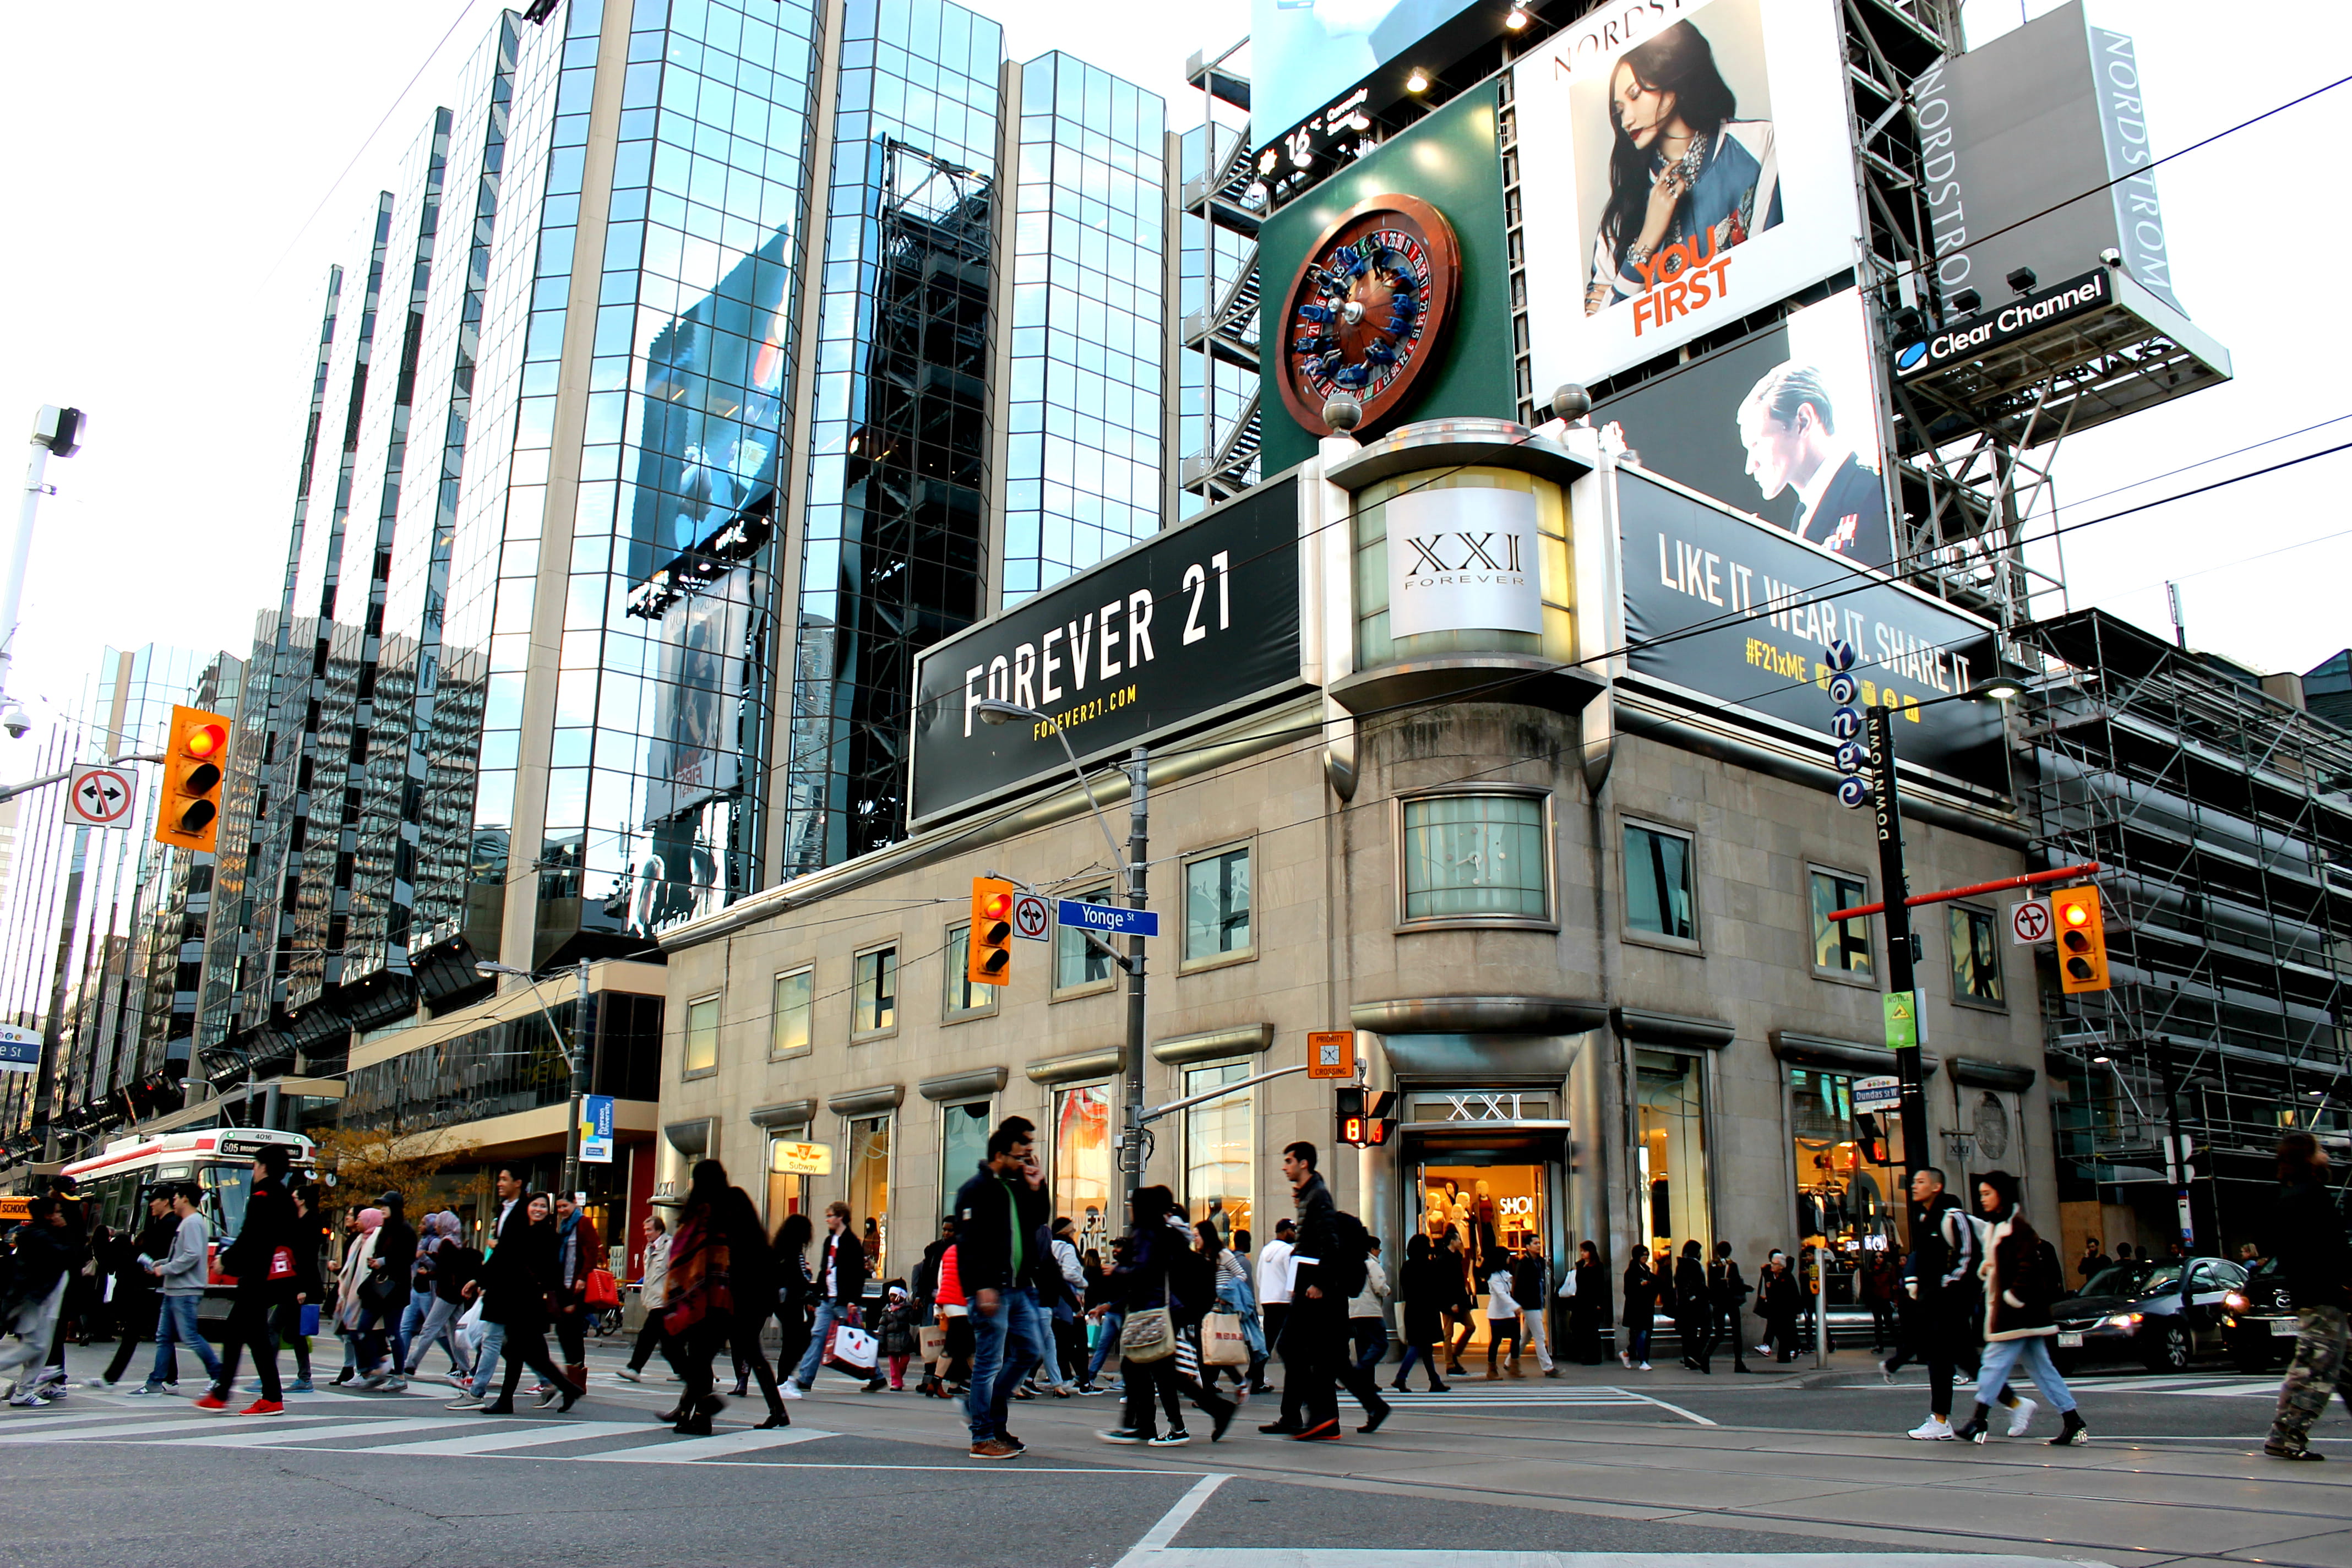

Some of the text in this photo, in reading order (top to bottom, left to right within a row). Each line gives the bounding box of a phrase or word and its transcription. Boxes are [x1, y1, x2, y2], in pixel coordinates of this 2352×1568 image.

[1555, 0, 1680, 81] NORDS
[1285, 126, 1310, 160] 16
[2103, 31, 2170, 288] NORDSTROM
[1387, 232, 1397, 248] 26
[1395, 233, 1405, 250] 30
[1403, 238, 1412, 254] 11
[1413, 253, 1424, 269] 20
[1635, 225, 1716, 294] YOU
[1633, 256, 1732, 337] FIRST
[1419, 300, 1428, 313] 22
[1930, 275, 2102, 358] Clear Channel
[1308, 325, 1320, 335] 21
[1412, 328, 1420, 339] 15
[1403, 532, 1524, 576] XXI
[1405, 575, 1524, 590] FOREVER
[1659, 533, 1723, 607] LIKE
[1763, 575, 1837, 648] WEAR
[1875, 622, 1951, 694] SHARE
[963, 549, 1230, 738] FOREVER 21
[1746, 637, 1807, 684] #F21xME
[1033, 684, 1137, 742] FOREVER21.COM
[1869, 718, 1889, 841] DOWNTOWN
[1082, 905, 1135, 930] Yonge St
[1888, 994, 1911, 1003] NOTICE
[10, 1047, 21, 1057] St
[1856, 1090, 1882, 1101] Dundas
[1890, 1088, 1897, 1096] W
[1445, 1093, 1523, 1121] XXI
[224, 1143, 238, 1152] 505
[1951, 1145, 1969, 1153] XXI
[789, 1162, 817, 1173] Subway
[655, 1182, 674, 1196] XXI
[2, 1204, 28, 1213] SCHOOL
